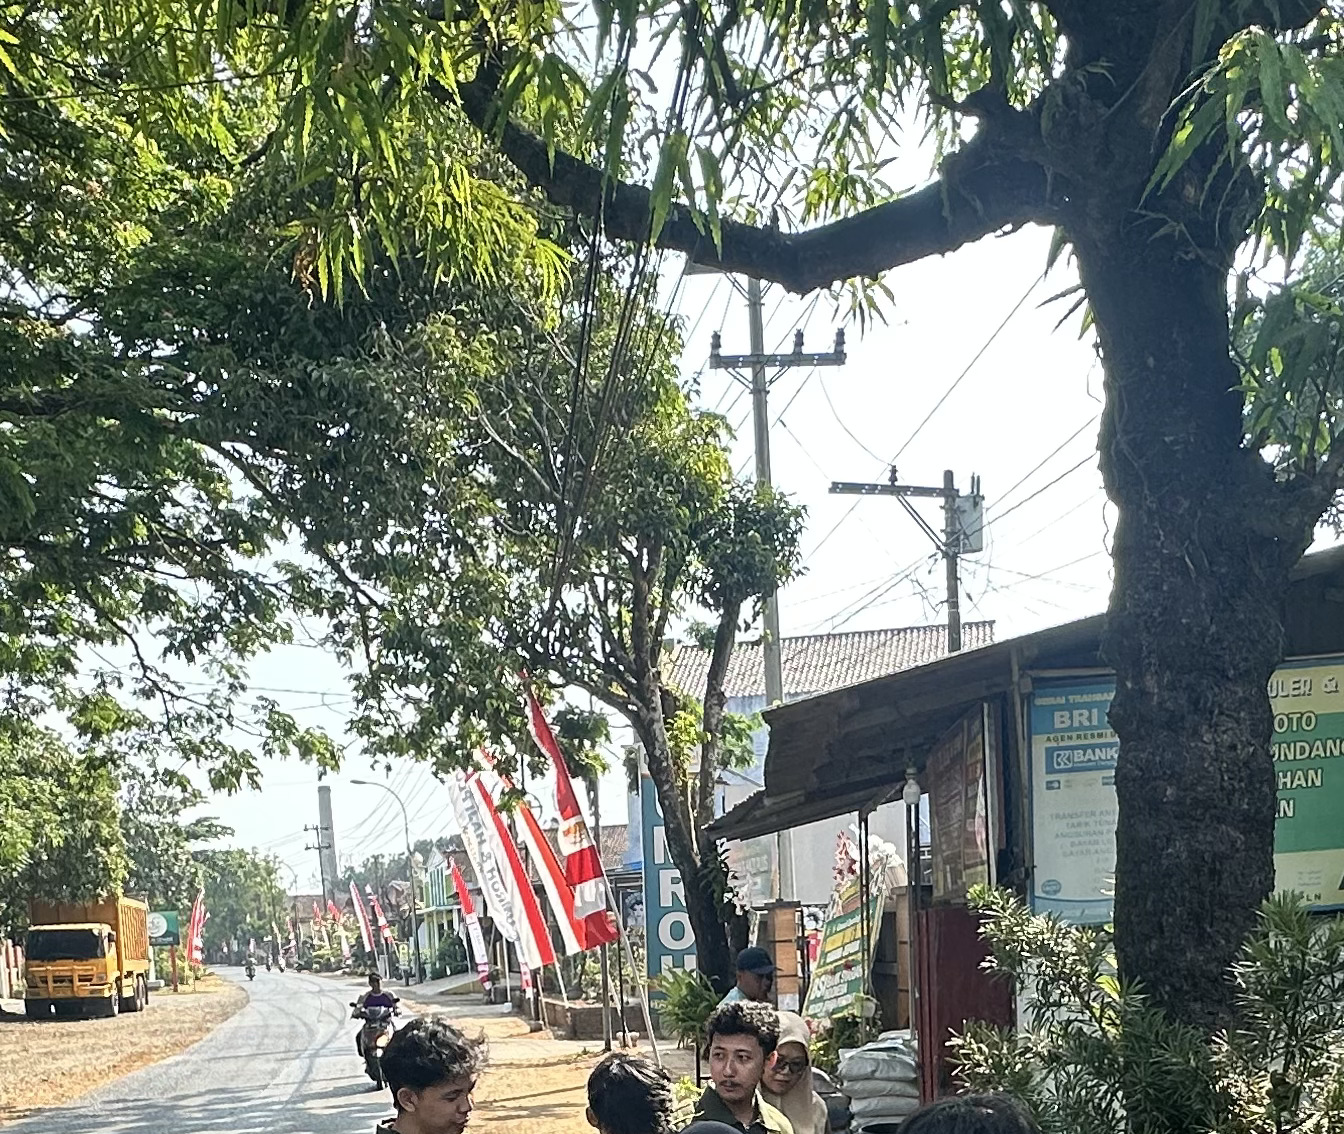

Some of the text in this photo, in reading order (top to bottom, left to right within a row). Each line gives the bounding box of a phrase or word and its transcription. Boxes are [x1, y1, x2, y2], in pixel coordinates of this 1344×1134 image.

[1322, 676, 1340, 694] &
[1053, 707, 1099, 729] BRI
[1273, 712, 1317, 733] OTO
[1073, 746, 1119, 762] BANK
[1274, 799, 1295, 818] N
